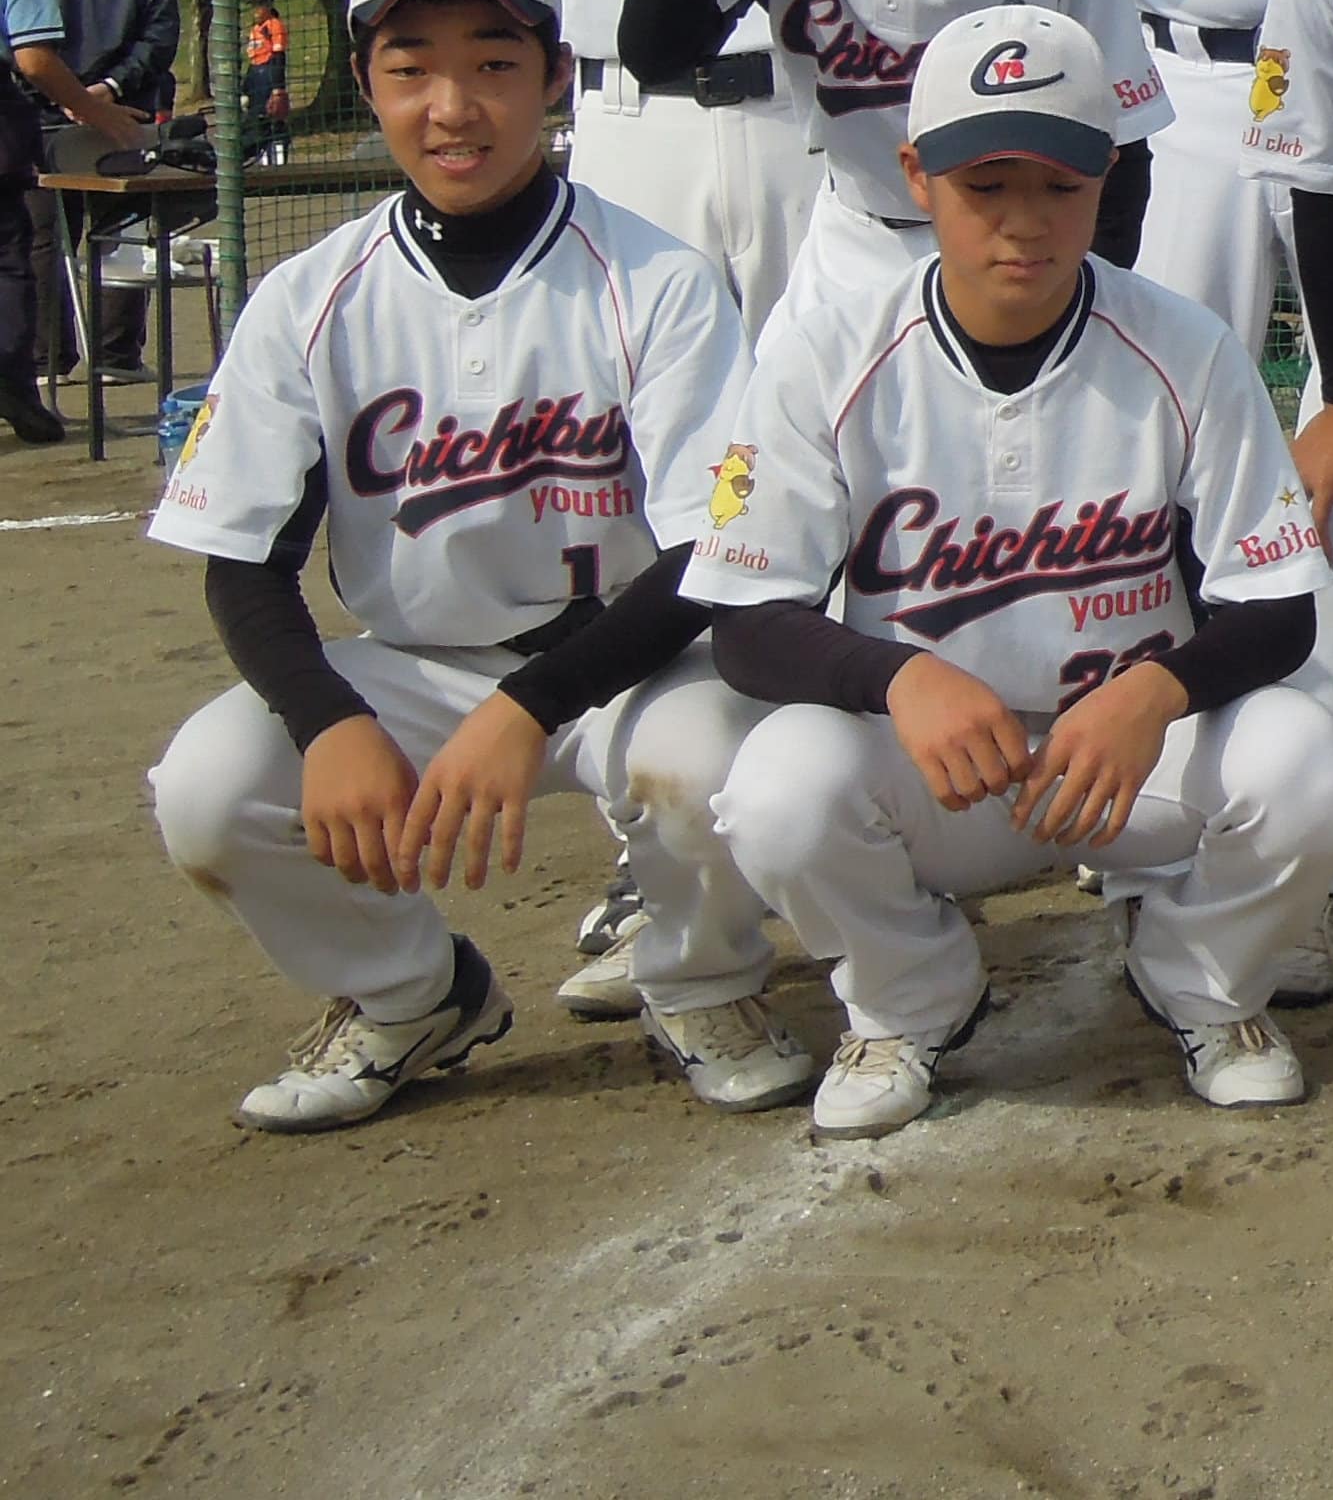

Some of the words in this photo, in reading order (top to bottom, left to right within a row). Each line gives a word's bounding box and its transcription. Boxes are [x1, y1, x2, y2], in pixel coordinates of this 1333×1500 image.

[531, 477, 634, 523] youth
[849, 487, 1171, 595] Chichibu
[1235, 522, 1319, 568] Saita
[1068, 572, 1172, 632] youth
